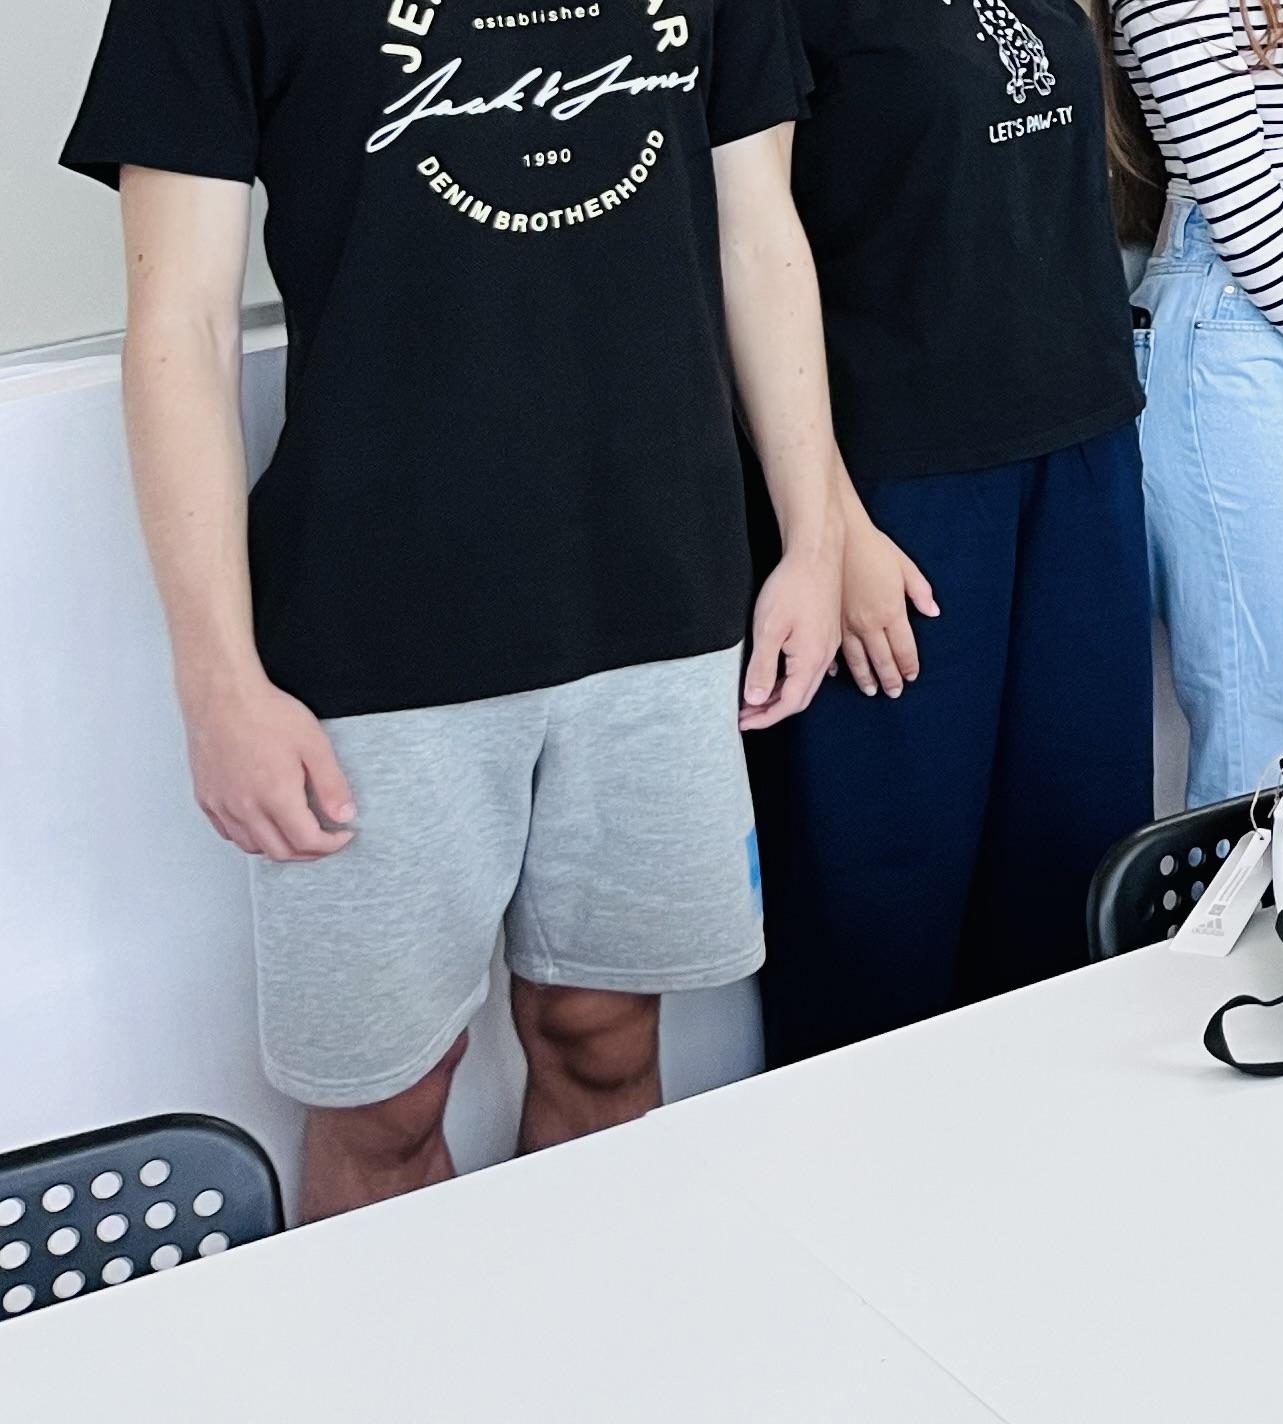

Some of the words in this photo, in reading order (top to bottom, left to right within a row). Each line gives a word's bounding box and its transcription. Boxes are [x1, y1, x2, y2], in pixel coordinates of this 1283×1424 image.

[473, 3, 600, 30] established
[366, 57, 542, 153] Jack
[989, 121, 1024, 143] LET'S
[523, 149, 571, 167] 1990
[417, 155, 492, 224] DENIM
[493, 130, 664, 232] BROTHERHOOD
